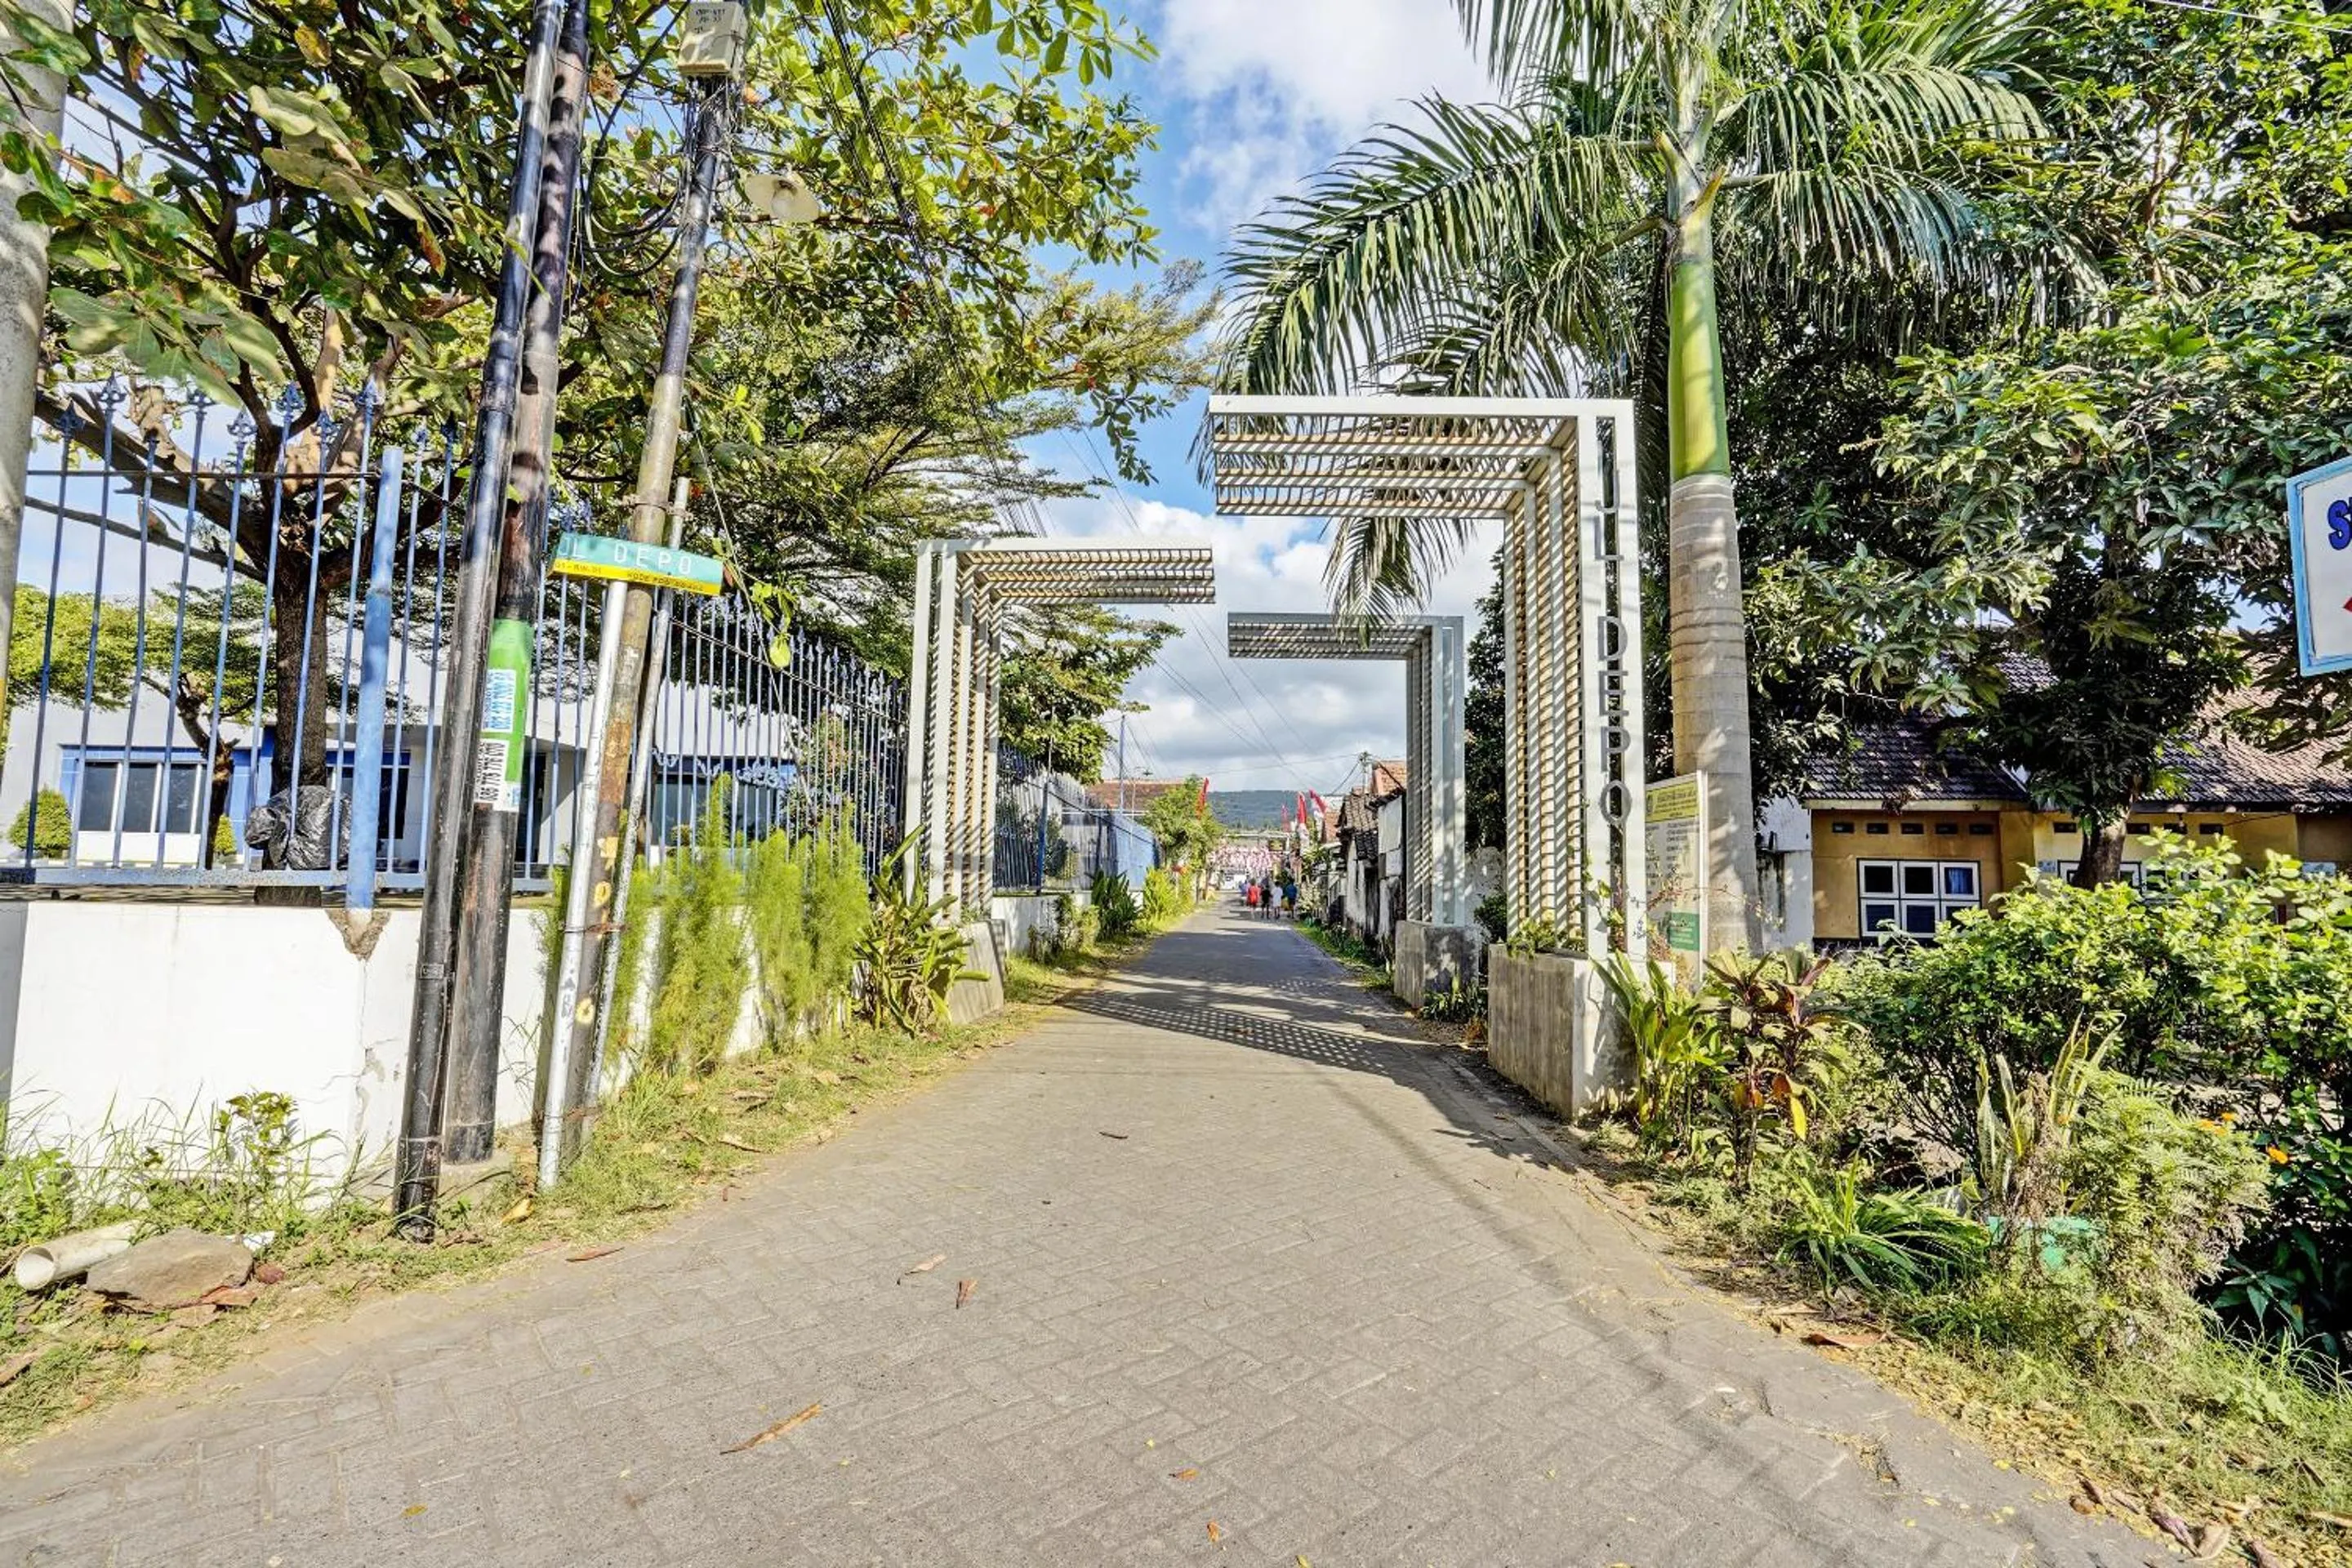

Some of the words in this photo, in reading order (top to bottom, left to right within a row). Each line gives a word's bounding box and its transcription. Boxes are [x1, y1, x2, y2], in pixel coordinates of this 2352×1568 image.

[2328, 497, 2352, 550] S
[614, 542, 692, 574] DEPO
[1597, 616, 1633, 826] DEPO
